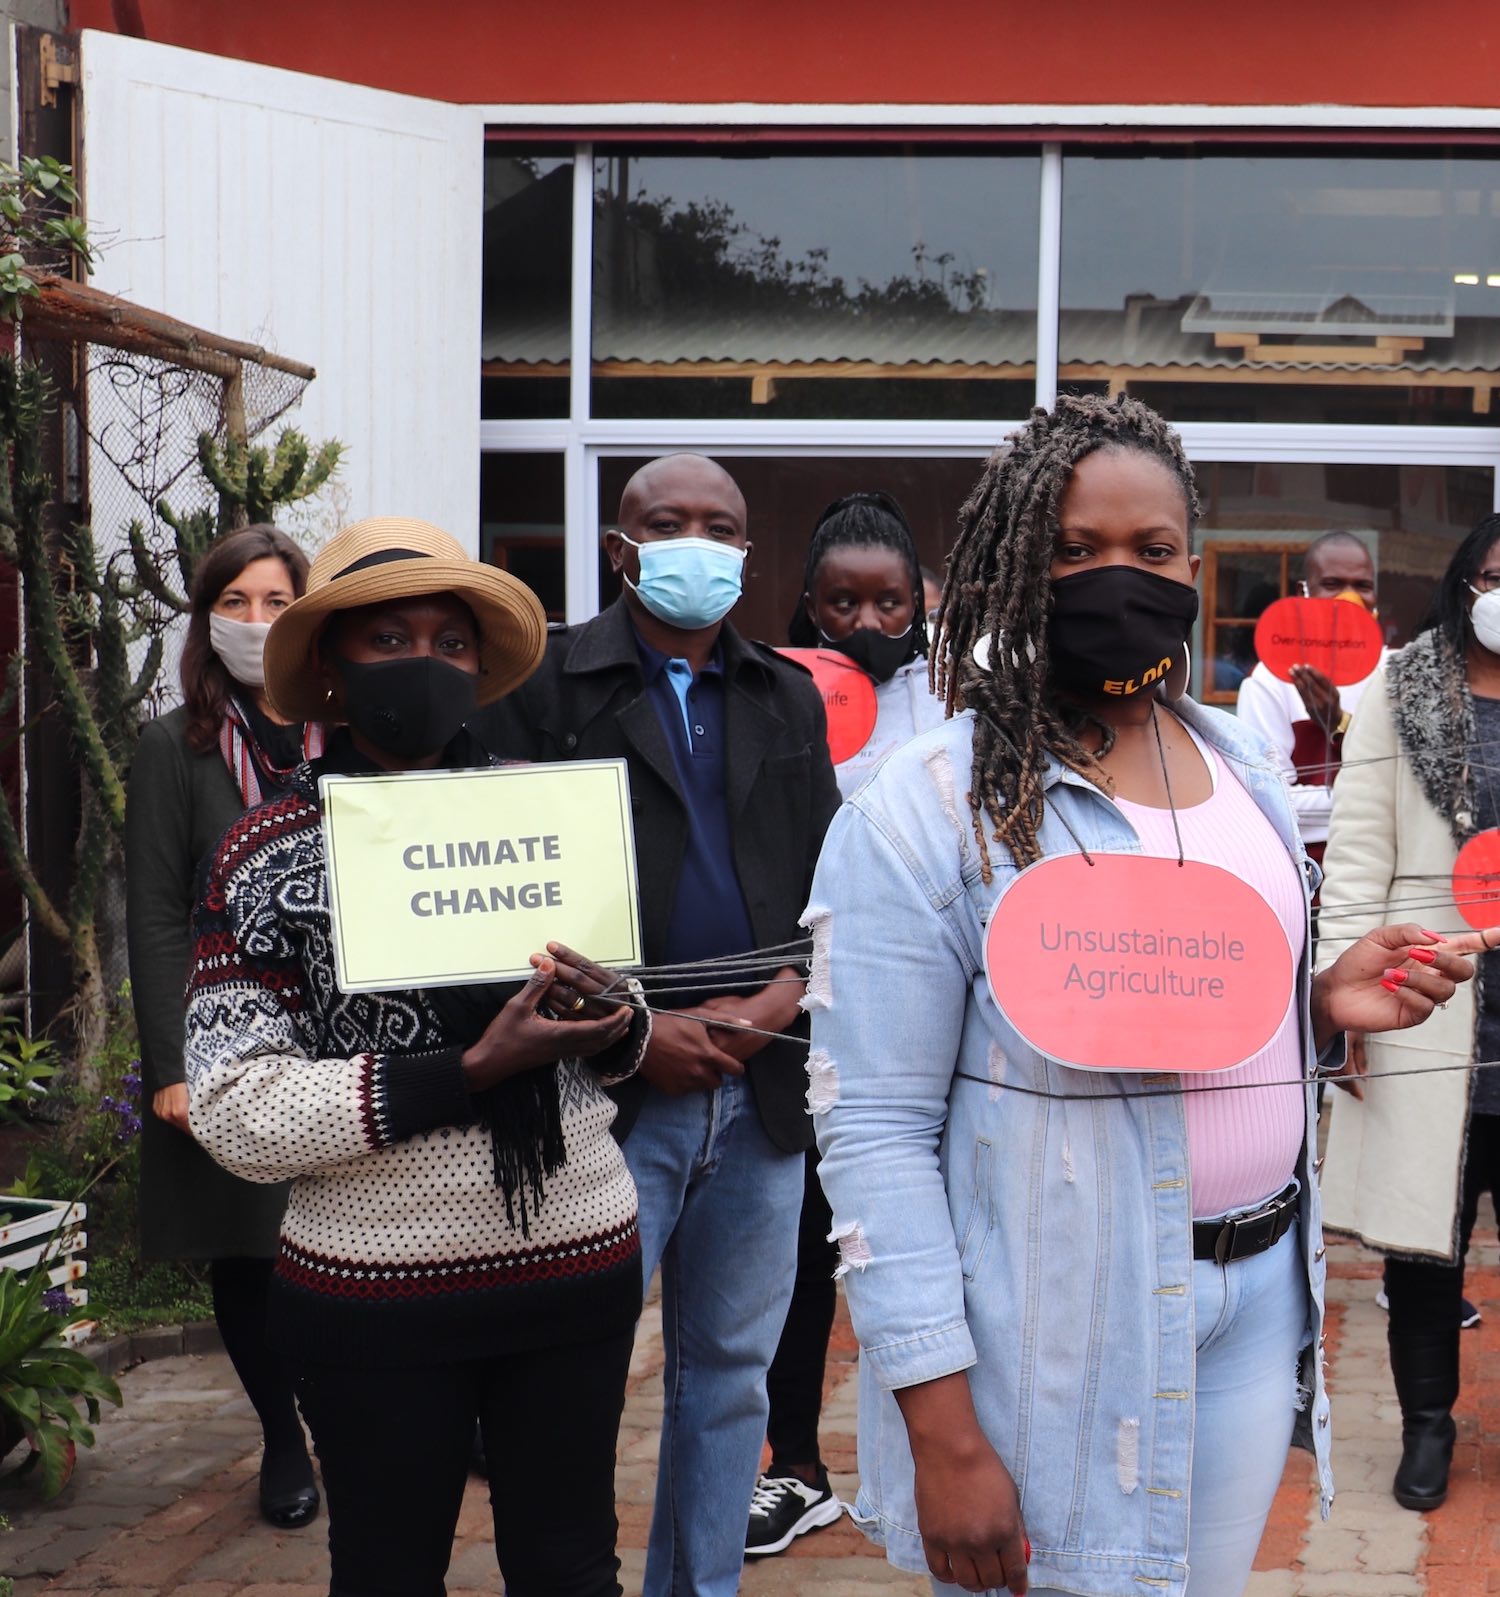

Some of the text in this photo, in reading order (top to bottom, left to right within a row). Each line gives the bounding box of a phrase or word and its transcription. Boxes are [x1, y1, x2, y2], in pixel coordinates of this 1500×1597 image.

[402, 835, 562, 871] CLIMATE
[410, 881, 563, 917] CHANGE
[1040, 922, 1245, 961] Unsustainable
[1064, 963, 1225, 999] Agriculture
